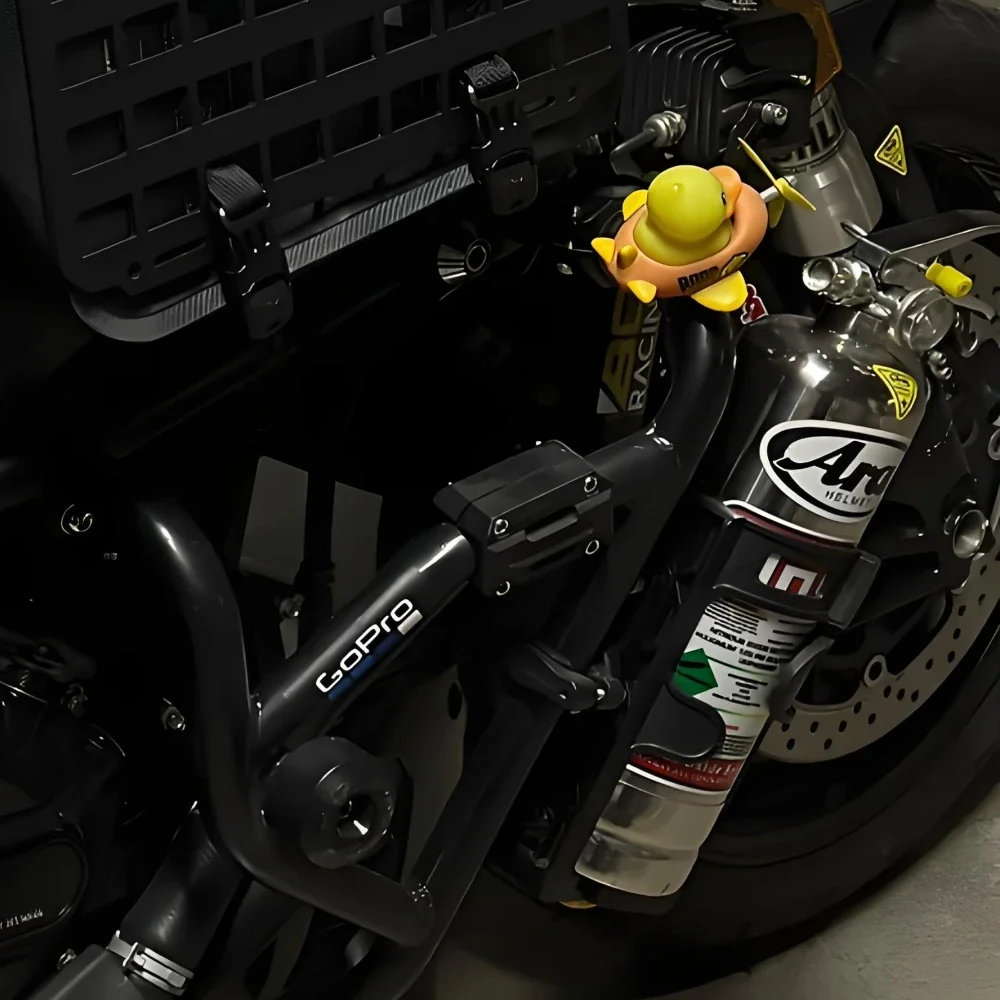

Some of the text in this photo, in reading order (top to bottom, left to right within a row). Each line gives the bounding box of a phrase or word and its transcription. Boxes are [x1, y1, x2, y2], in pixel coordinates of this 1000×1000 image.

[627, 298, 662, 411] RACIN
[775, 440, 897, 497] Ara
[315, 598, 414, 693] GoPro
